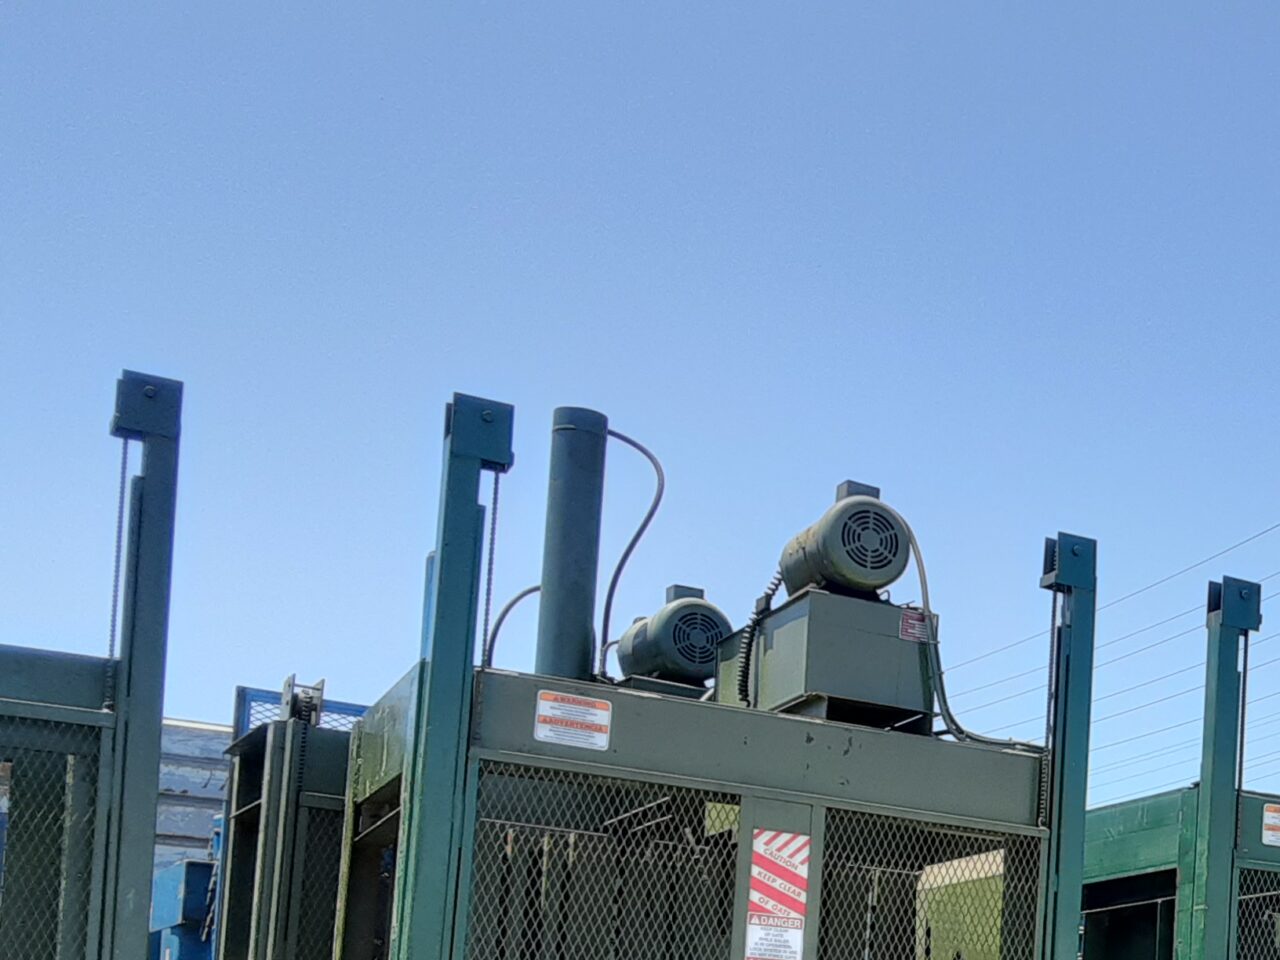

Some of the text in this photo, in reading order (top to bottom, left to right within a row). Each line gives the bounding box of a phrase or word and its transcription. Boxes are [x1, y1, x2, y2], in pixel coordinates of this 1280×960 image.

[763, 848, 799, 871] CAUTION
[757, 870, 802, 899] KEEP CLEAR
[758, 896, 791, 917] OF GATE
[761, 916, 801, 928] DANGER
